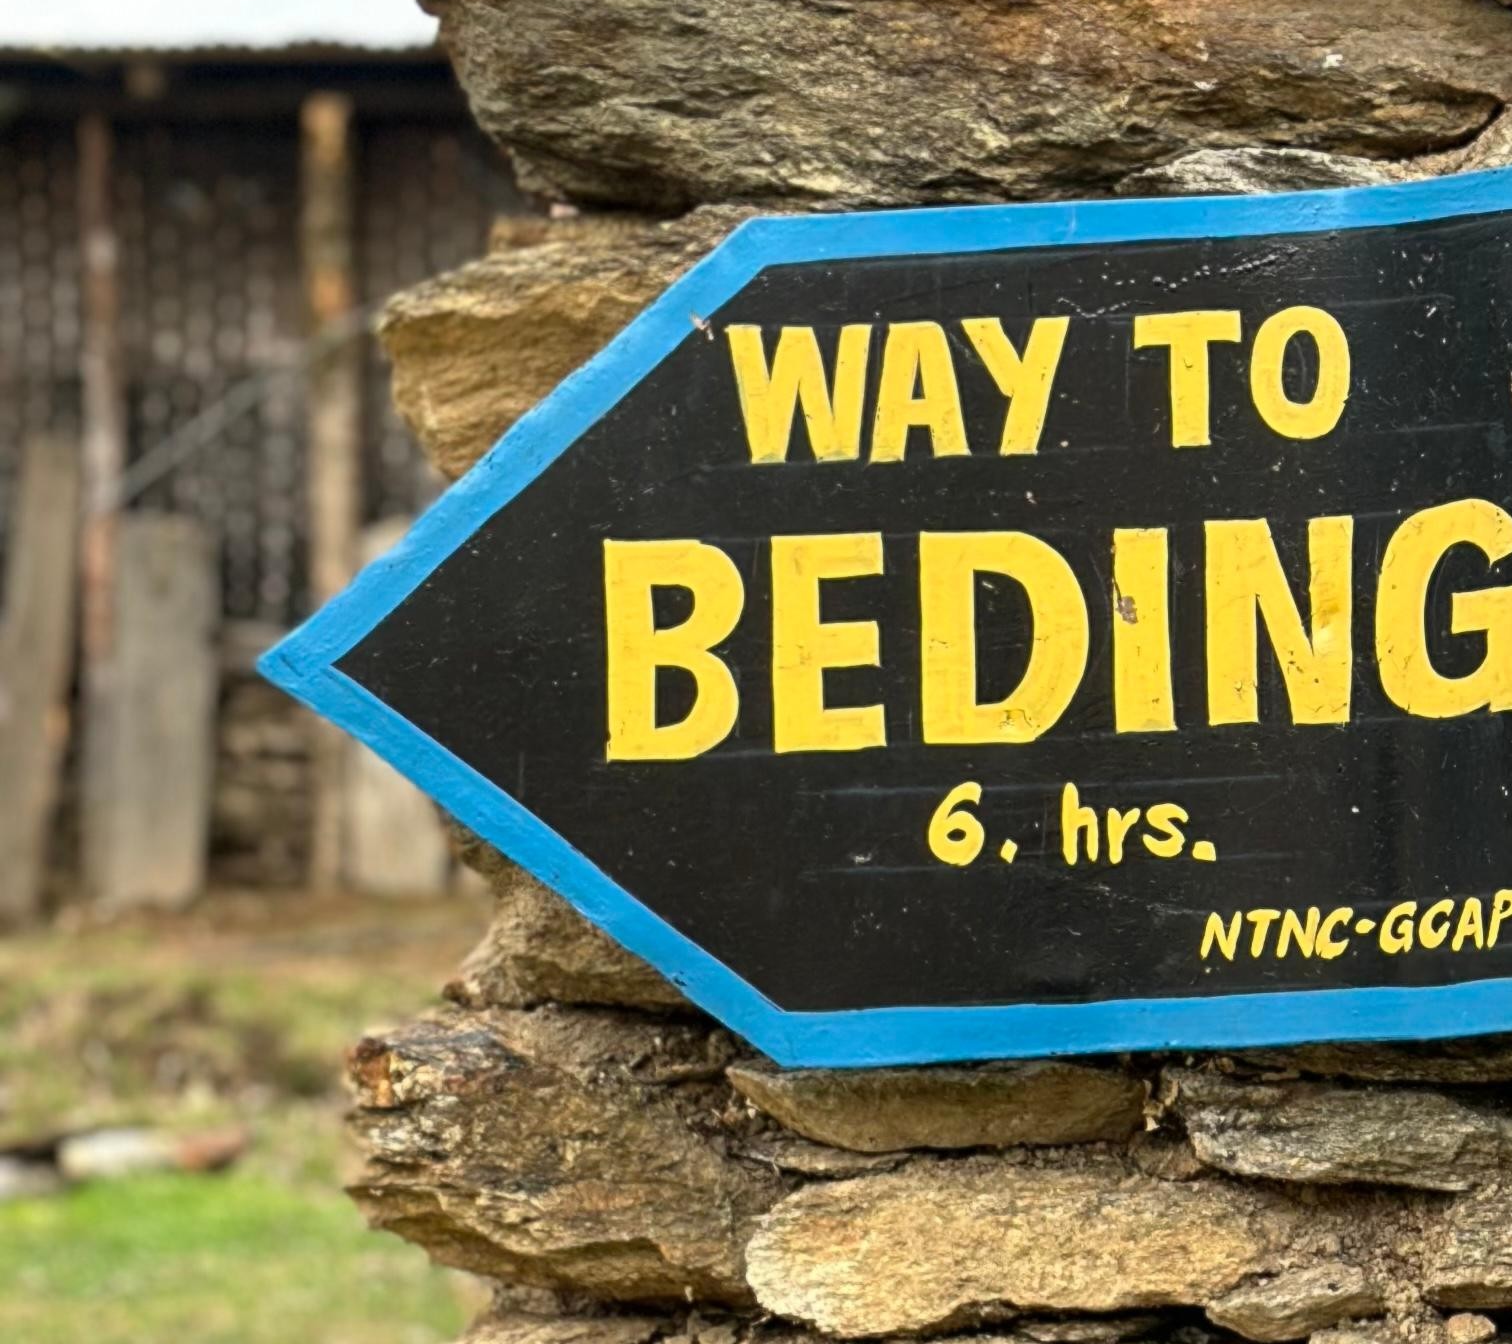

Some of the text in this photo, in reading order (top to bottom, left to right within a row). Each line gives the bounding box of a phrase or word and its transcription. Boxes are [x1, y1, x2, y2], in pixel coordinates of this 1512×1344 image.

[726, 305, 1351, 463] WAY TO
[927, 782, 1217, 866] 6. hrs.
